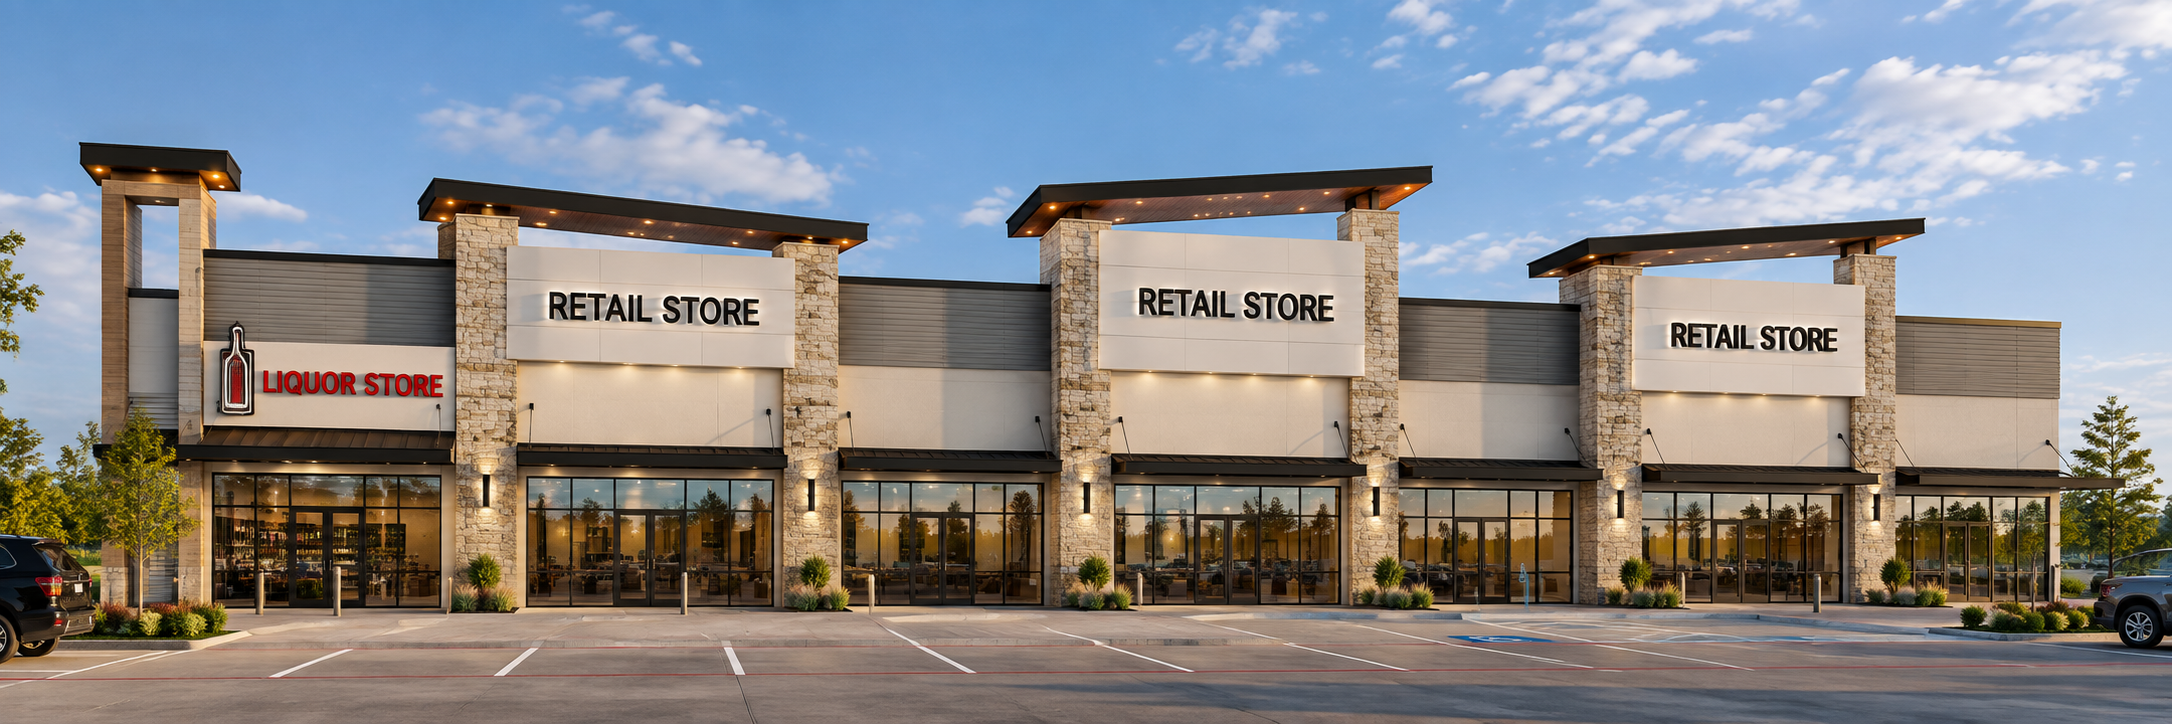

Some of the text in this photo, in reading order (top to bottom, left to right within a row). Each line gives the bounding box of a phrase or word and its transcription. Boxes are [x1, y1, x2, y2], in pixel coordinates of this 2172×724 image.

[549, 292, 759, 326] RETAIL STORE
[1139, 287, 1334, 322] RETAIL STORE
[1671, 322, 1838, 352] RETAIL STORE
[263, 370, 443, 397] LIQUOR STORE
